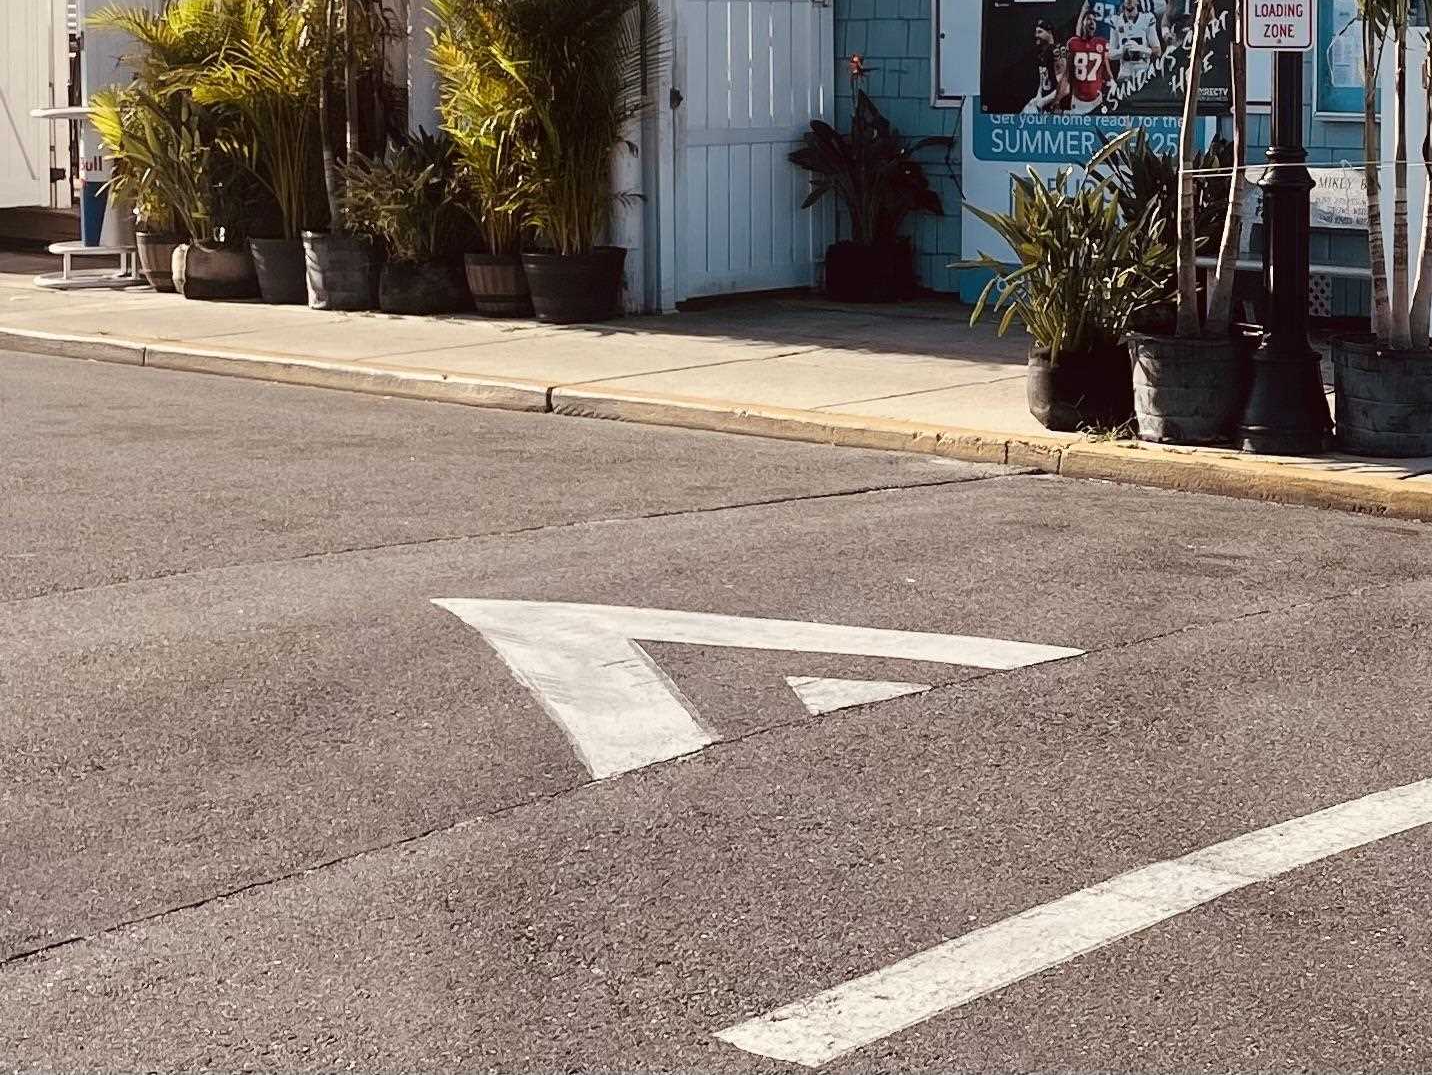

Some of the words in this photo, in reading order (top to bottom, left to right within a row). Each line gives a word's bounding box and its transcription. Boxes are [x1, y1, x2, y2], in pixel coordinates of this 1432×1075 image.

[1254, 3, 1304, 18] LOADING
[1182, 10, 1229, 50] SART
[1263, 24, 1296, 39] ZONE
[1073, 51, 1103, 82] 87
[1052, 115, 1093, 127] home
[991, 128, 1095, 155] SUMMER
